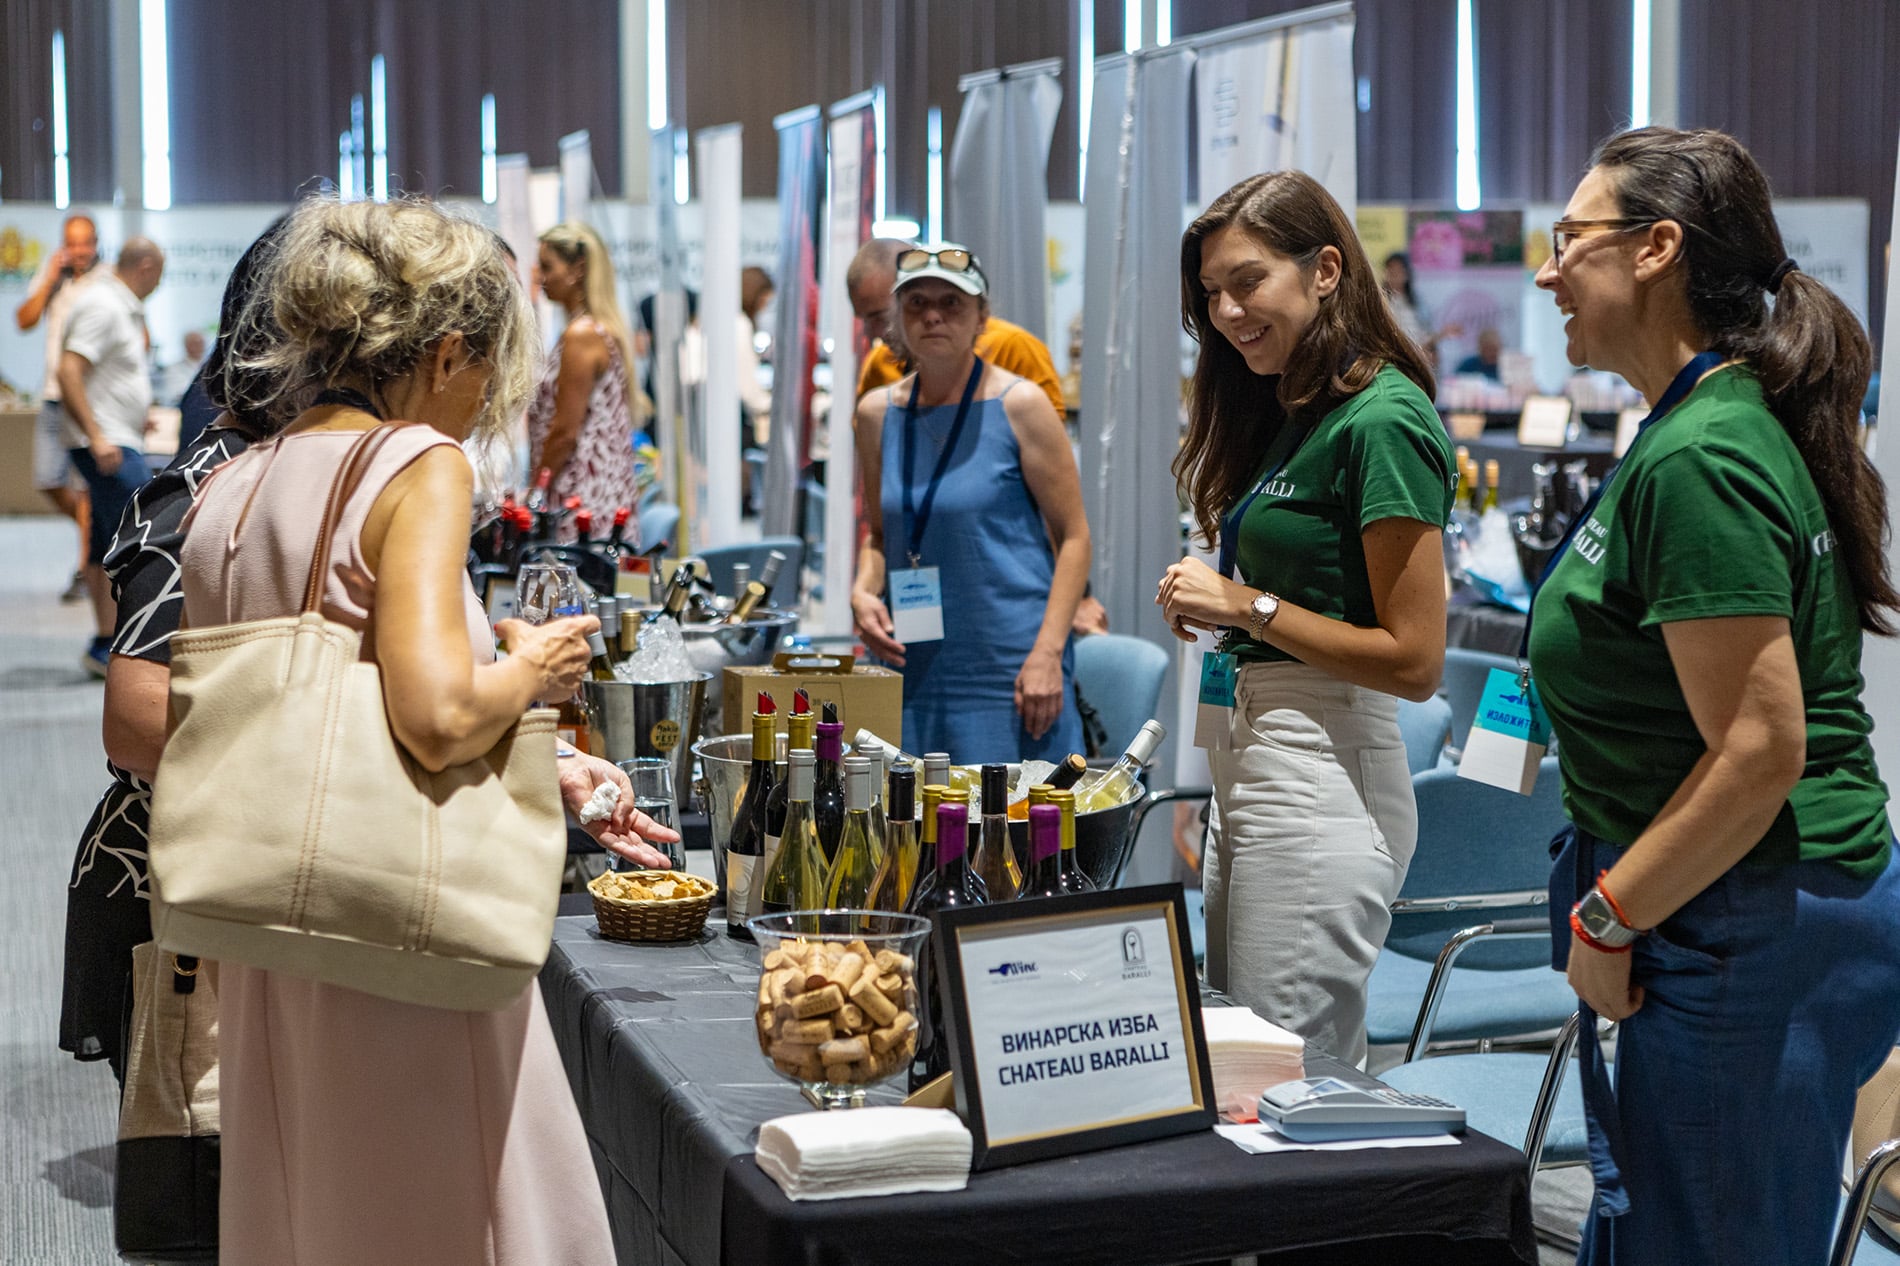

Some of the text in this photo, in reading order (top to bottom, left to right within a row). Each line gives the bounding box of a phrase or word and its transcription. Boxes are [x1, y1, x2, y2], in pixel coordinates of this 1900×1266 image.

[1251, 480, 1296, 498] ALLI
[1572, 525, 1606, 565] ALLI
[1002, 1013, 1159, 1053] ВИНАРСКА ИЗБА
[998, 1042, 1170, 1086] CHATEAU BARALLI
